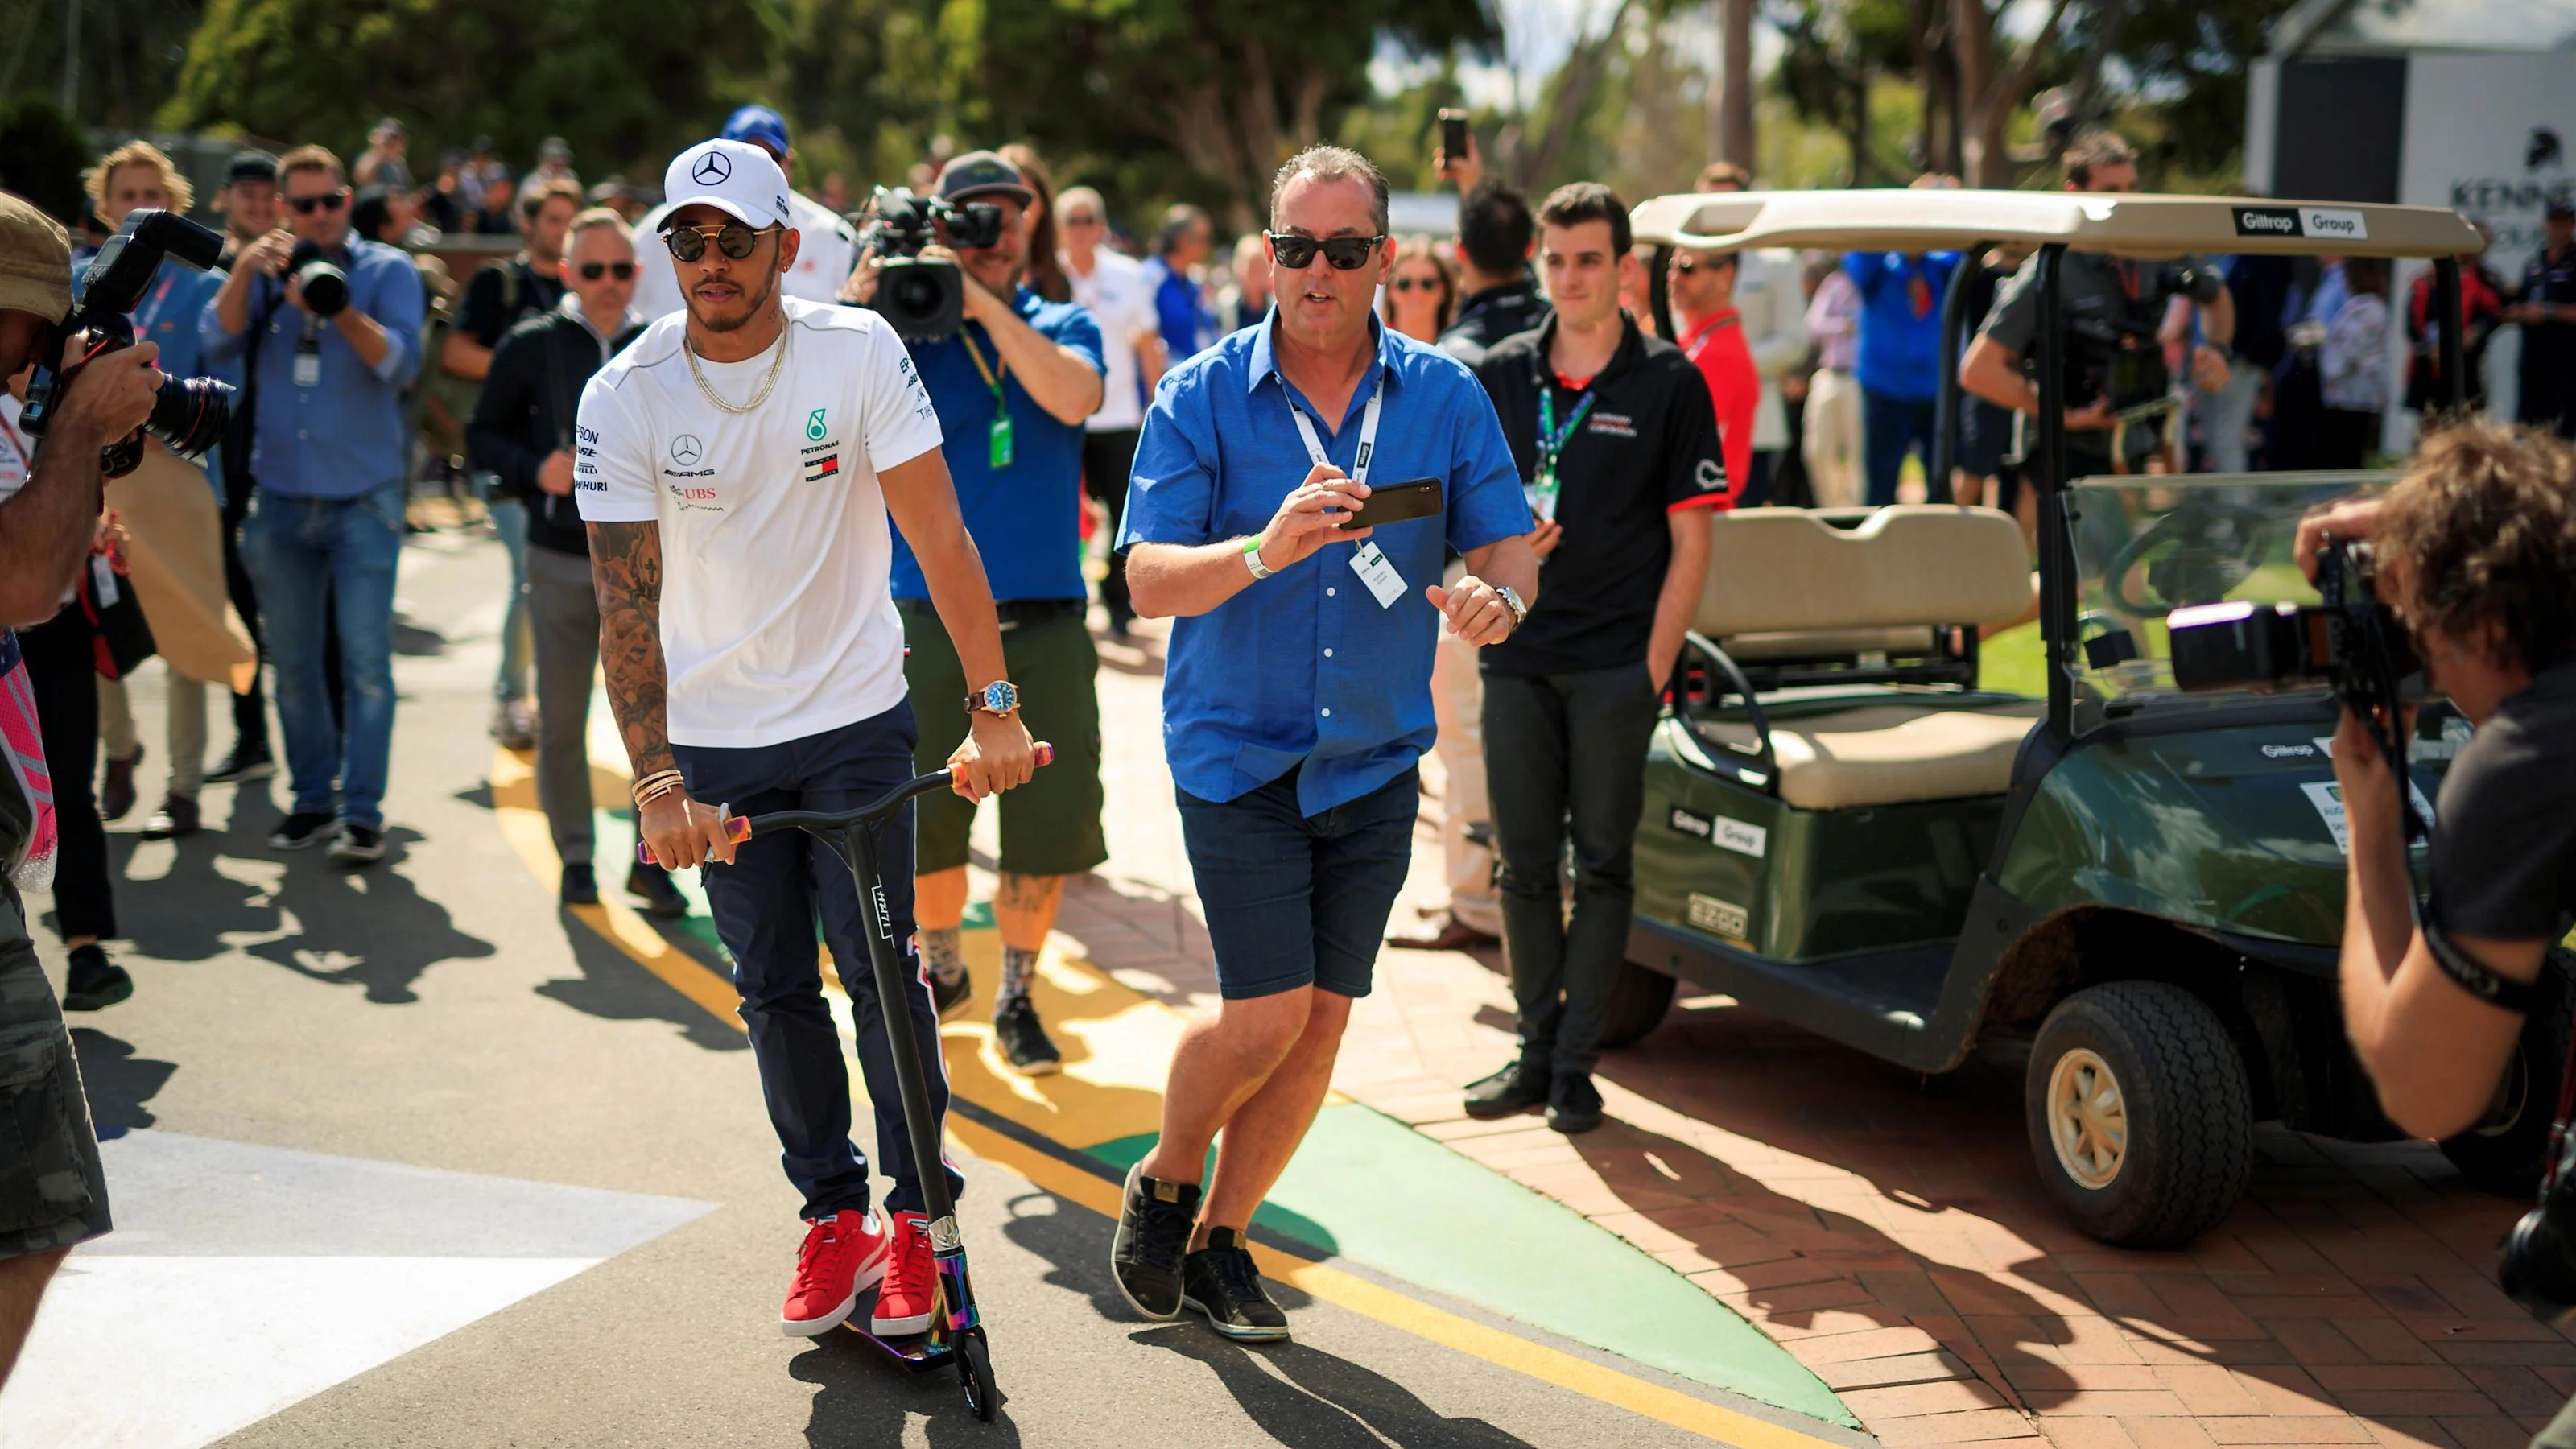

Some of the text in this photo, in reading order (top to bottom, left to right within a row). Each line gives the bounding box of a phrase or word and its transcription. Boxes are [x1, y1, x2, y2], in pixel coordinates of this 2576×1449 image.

[2242, 211, 2355, 234] Giltrap Group
[801, 440, 840, 455] PETRONAS
[679, 469, 715, 477] AMG
[685, 487, 716, 499] UBS
[2261, 744, 2314, 758] Giltrap
